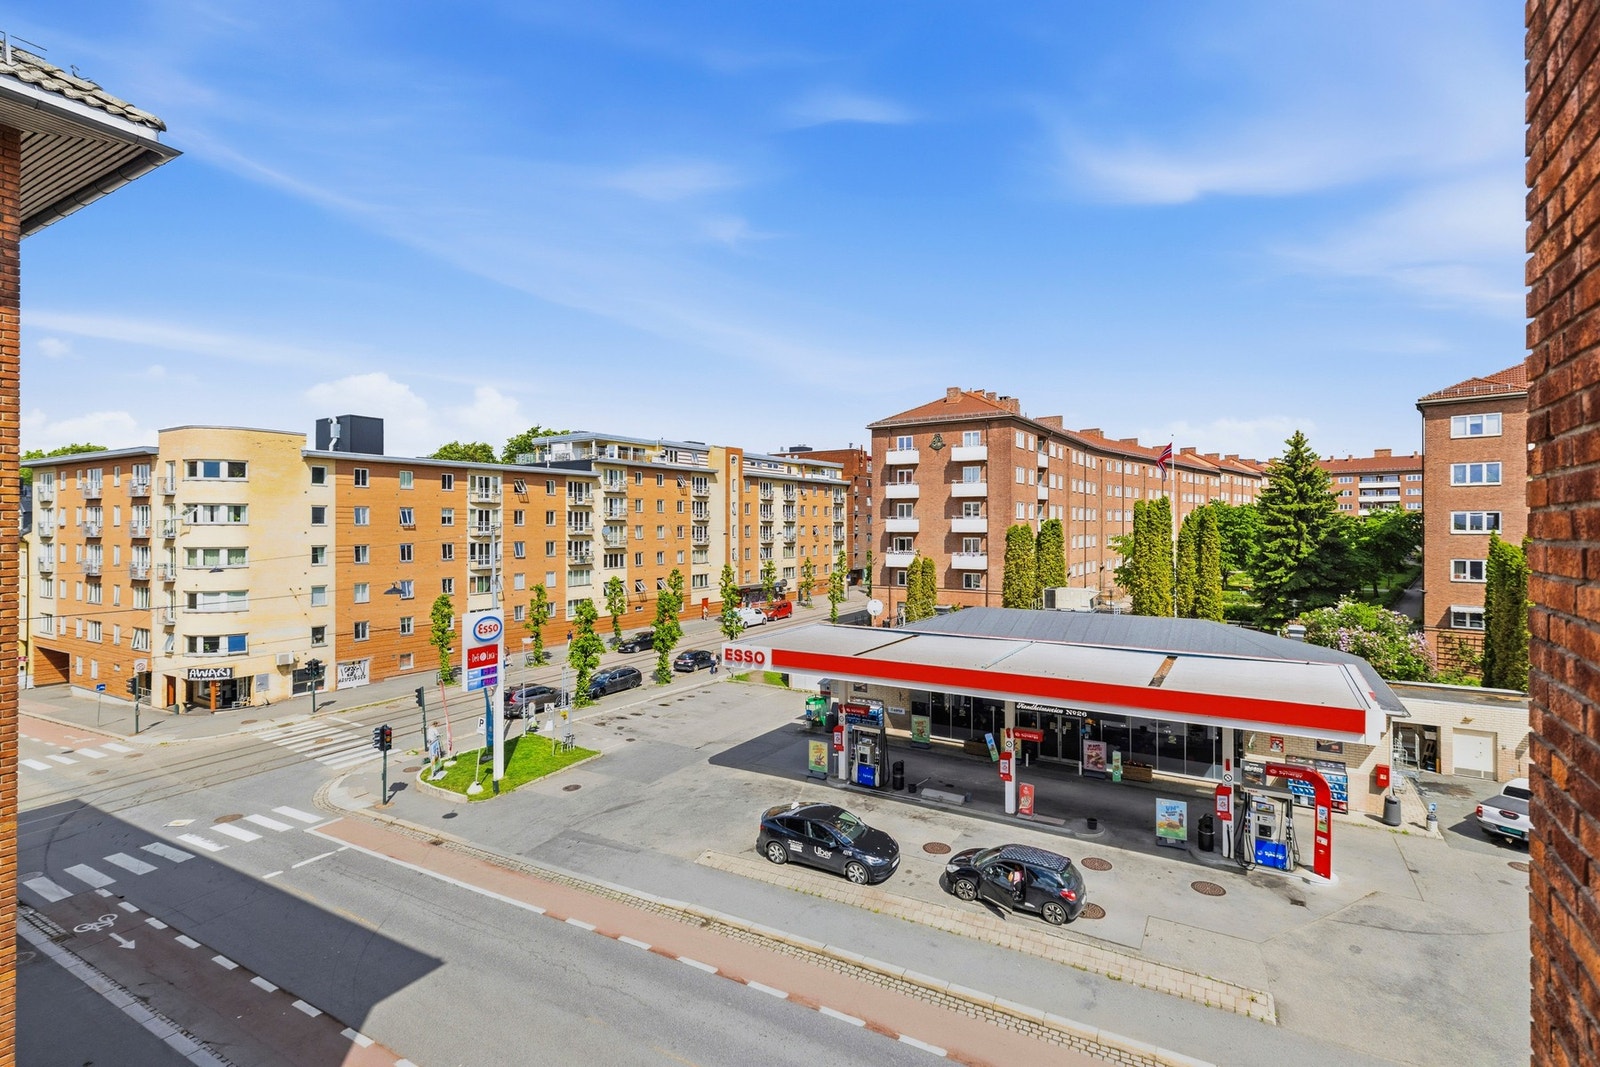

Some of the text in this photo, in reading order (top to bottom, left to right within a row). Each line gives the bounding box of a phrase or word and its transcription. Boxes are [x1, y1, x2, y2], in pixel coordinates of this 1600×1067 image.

[478, 623, 499, 635] Esso
[724, 648, 766, 664] ESSO
[189, 667, 231, 678] AWARI
[479, 719, 485, 728] P
[814, 846, 833, 859] Uber
